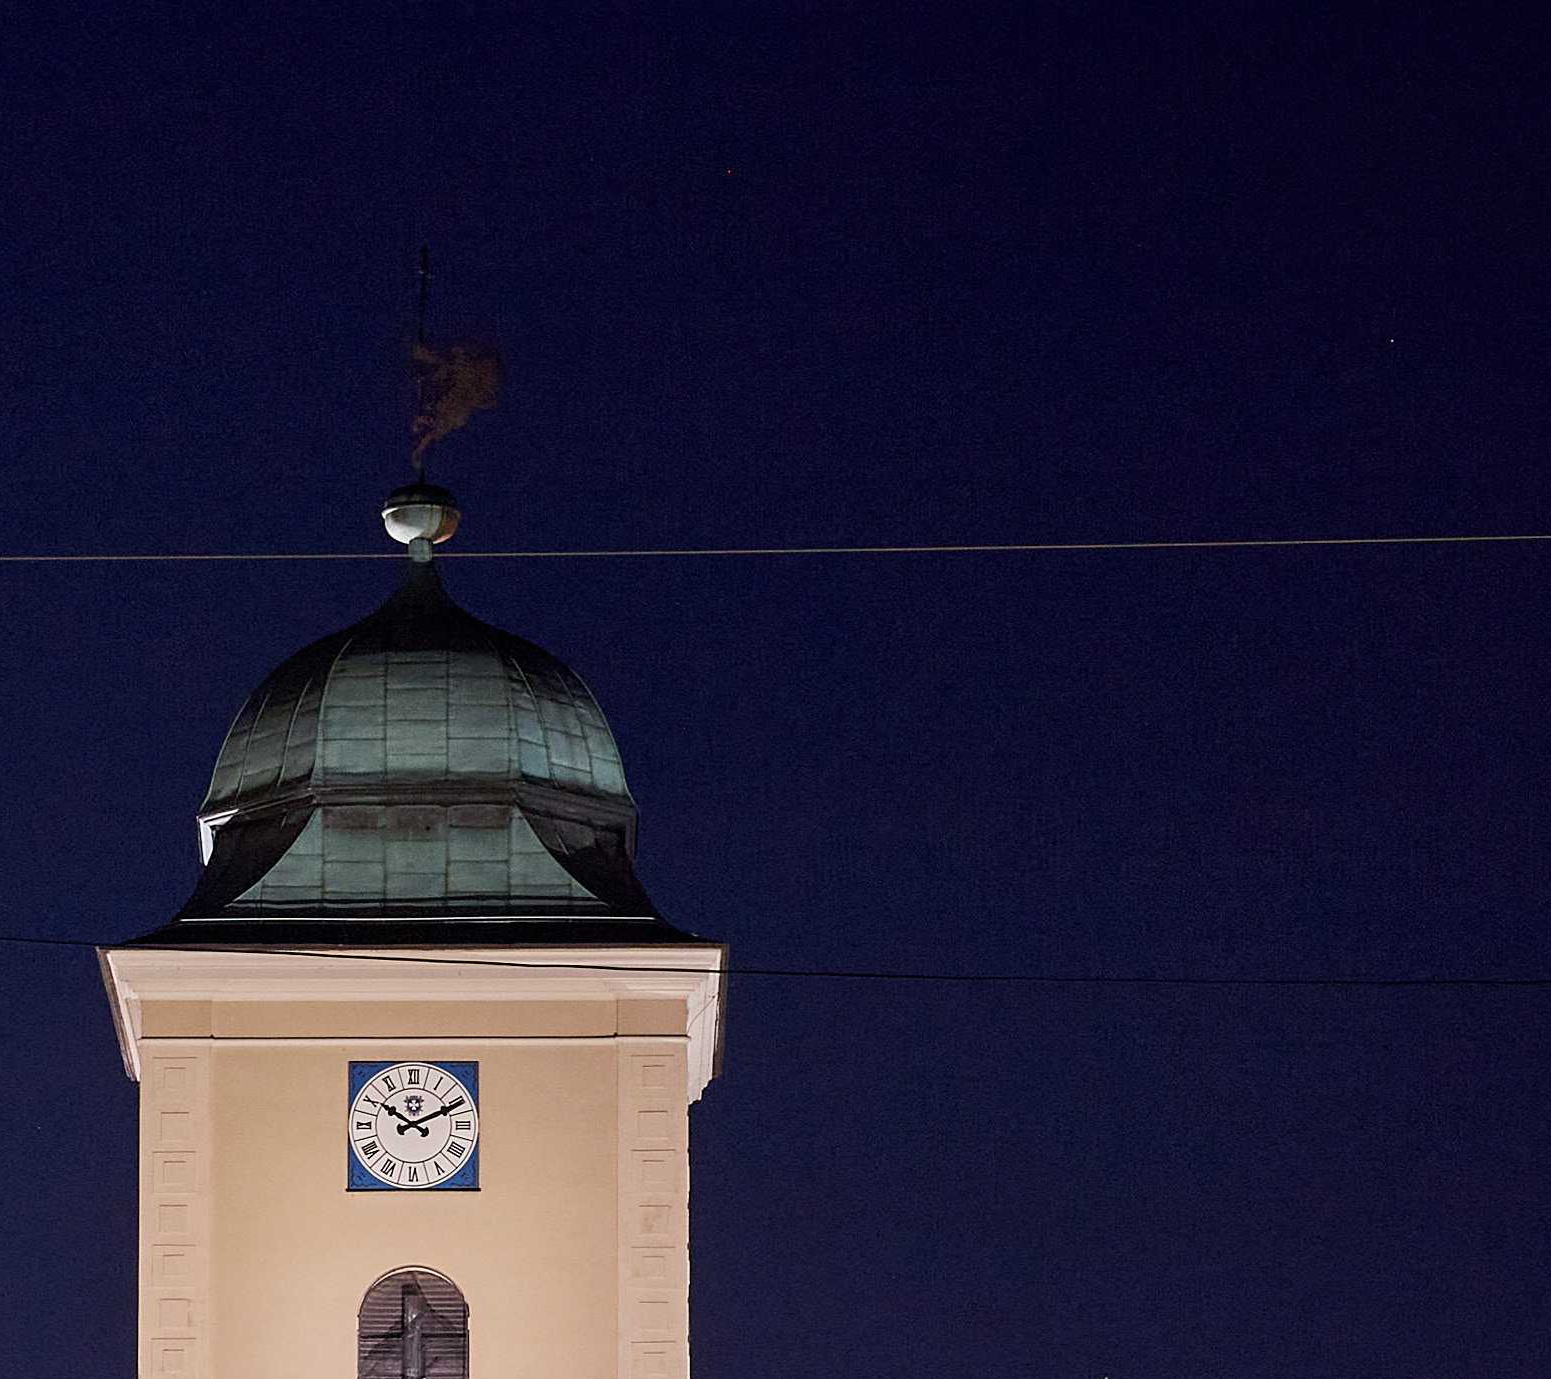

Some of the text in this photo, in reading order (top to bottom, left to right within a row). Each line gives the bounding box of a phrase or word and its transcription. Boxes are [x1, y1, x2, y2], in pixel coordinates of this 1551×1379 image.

[381, 1075, 397, 1092] XI
[407, 1069, 420, 1084] XII
[356, 1120, 371, 1130] IX
[455, 1120, 471, 1130] III
[380, 1158, 397, 1178] VII
[408, 1166, 418, 1182] VI
[433, 1161, 445, 1176] V
